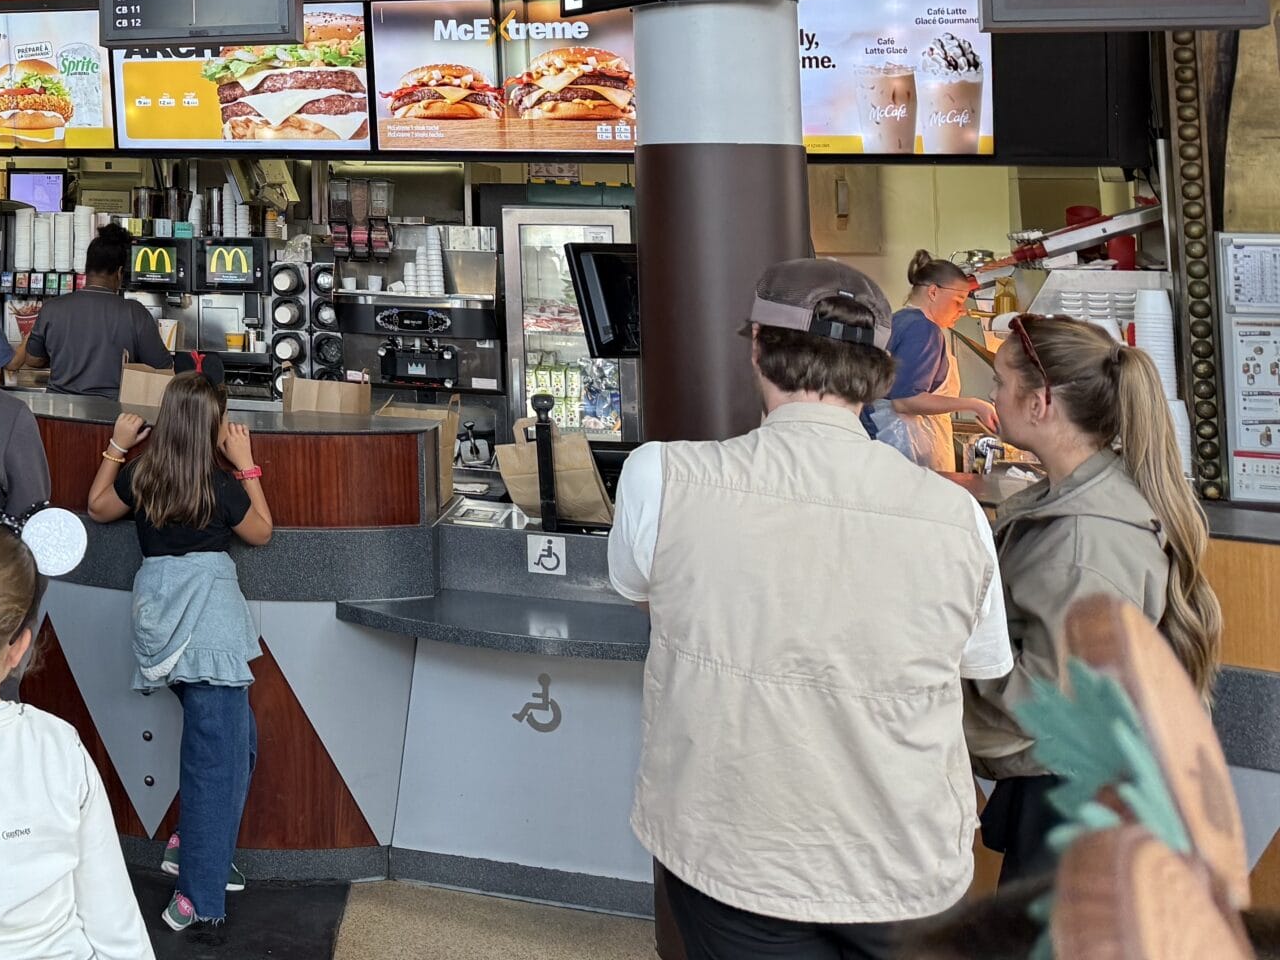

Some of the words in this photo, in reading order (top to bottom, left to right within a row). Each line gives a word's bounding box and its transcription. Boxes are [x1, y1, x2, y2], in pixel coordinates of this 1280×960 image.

[115, 6, 127, 14] CB
[130, 6, 141, 14] 11
[927, 8, 945, 16] Café
[115, 19, 127, 27] CB
[131, 19, 142, 27] 12
[915, 17, 937, 25] Glacé
[60, 56, 99, 76] Sprite
[870, 103, 908, 121] McCafé
[930, 109, 971, 127] McCafé
